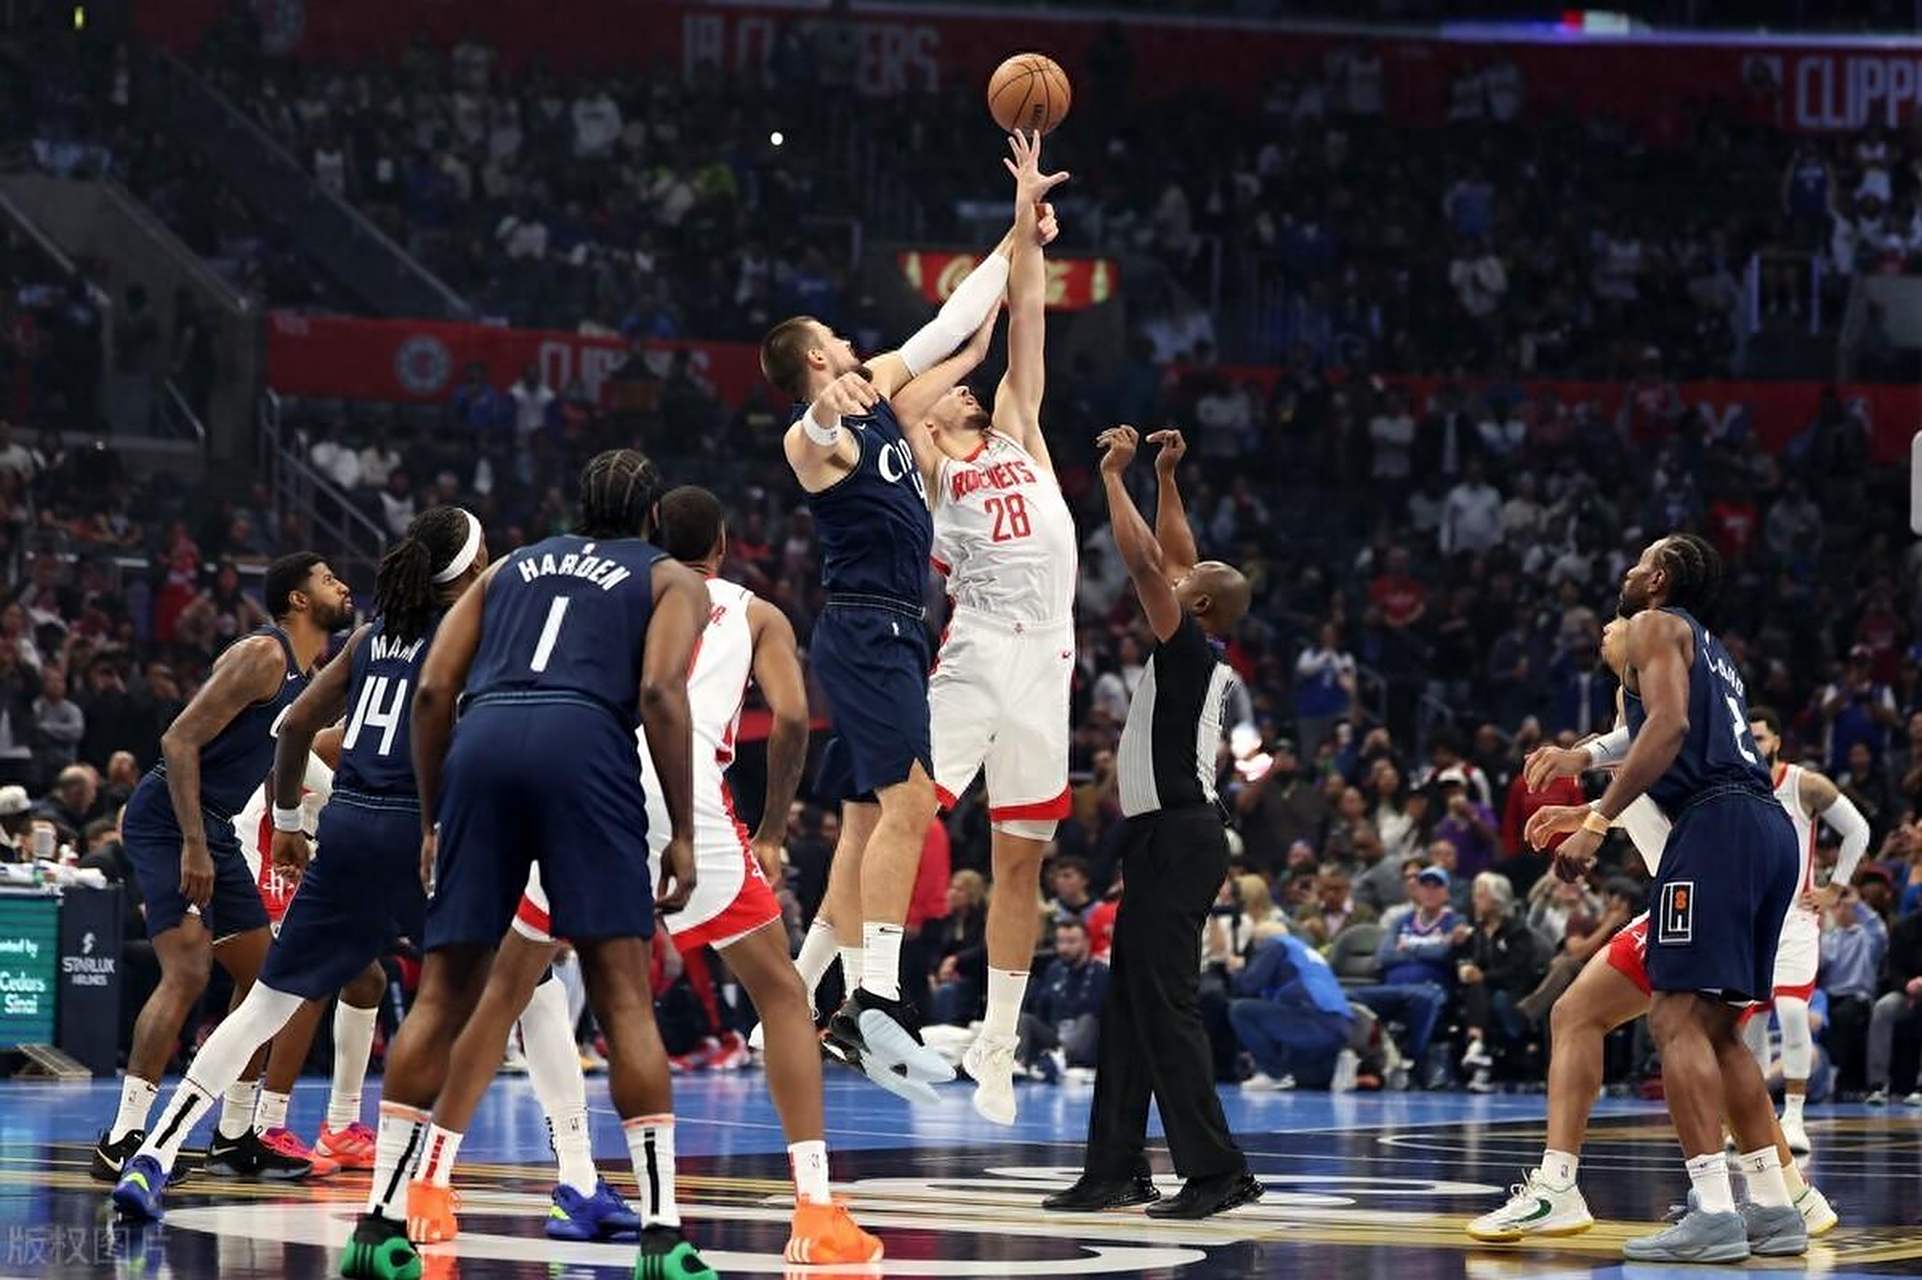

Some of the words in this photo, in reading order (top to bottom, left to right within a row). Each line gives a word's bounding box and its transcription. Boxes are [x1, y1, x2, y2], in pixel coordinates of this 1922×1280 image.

[1796, 56, 1922, 129] CLIPP
[984, 492, 1031, 543] 28
[517, 552, 630, 591] HARDEN
[530, 595, 570, 672] 1
[342, 675, 408, 756] 14
[0, 971, 46, 993] Cedars
[61, 956, 116, 974] STARLUX
[4, 993, 38, 1014] Sinai
